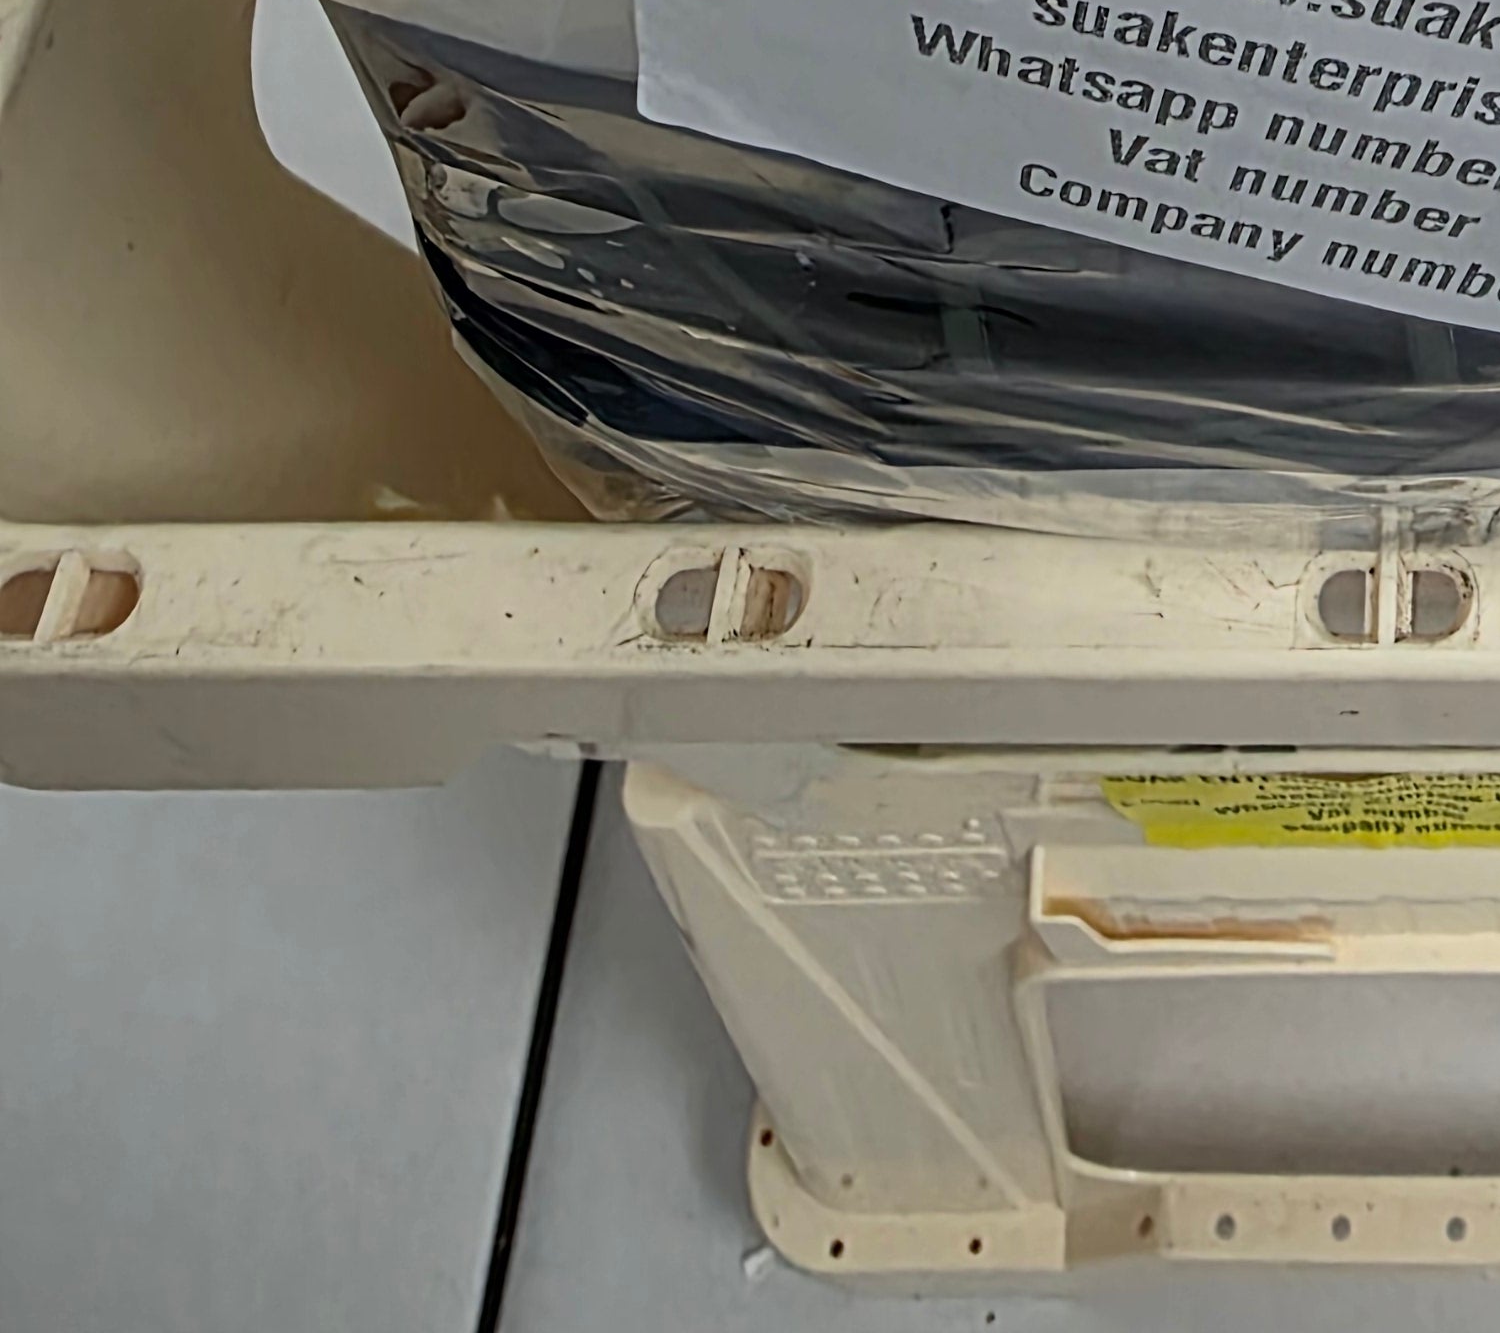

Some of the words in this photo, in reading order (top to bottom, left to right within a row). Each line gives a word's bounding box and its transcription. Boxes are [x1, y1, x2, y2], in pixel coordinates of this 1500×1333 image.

[911, 15, 1238, 134] Whatsapp
[1020, 161, 1303, 262] Company
[1107, 129, 1205, 183] Vat
[1229, 163, 1480, 239] number
